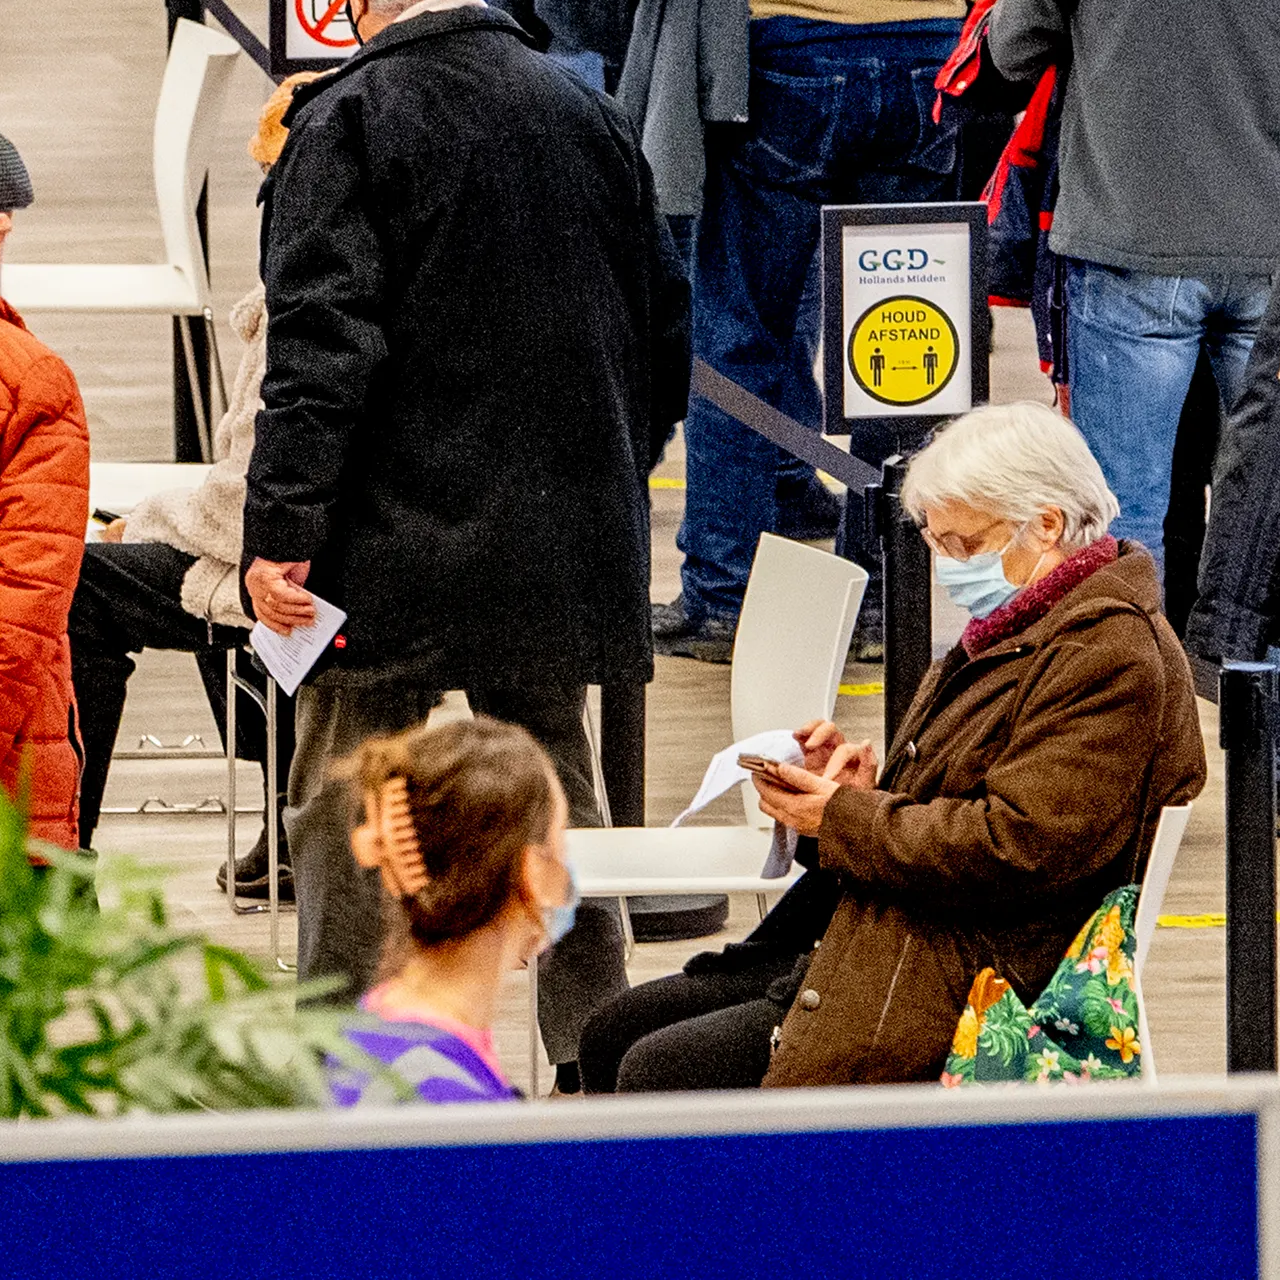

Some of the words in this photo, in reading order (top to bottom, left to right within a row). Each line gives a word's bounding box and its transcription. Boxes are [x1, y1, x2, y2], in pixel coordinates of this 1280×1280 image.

[858, 249, 928, 271] GGD
[859, 275, 905, 285] Hollands
[907, 273, 946, 284] Midden
[881, 310, 927, 324] HOUD
[868, 328, 940, 342] AFSTAND
